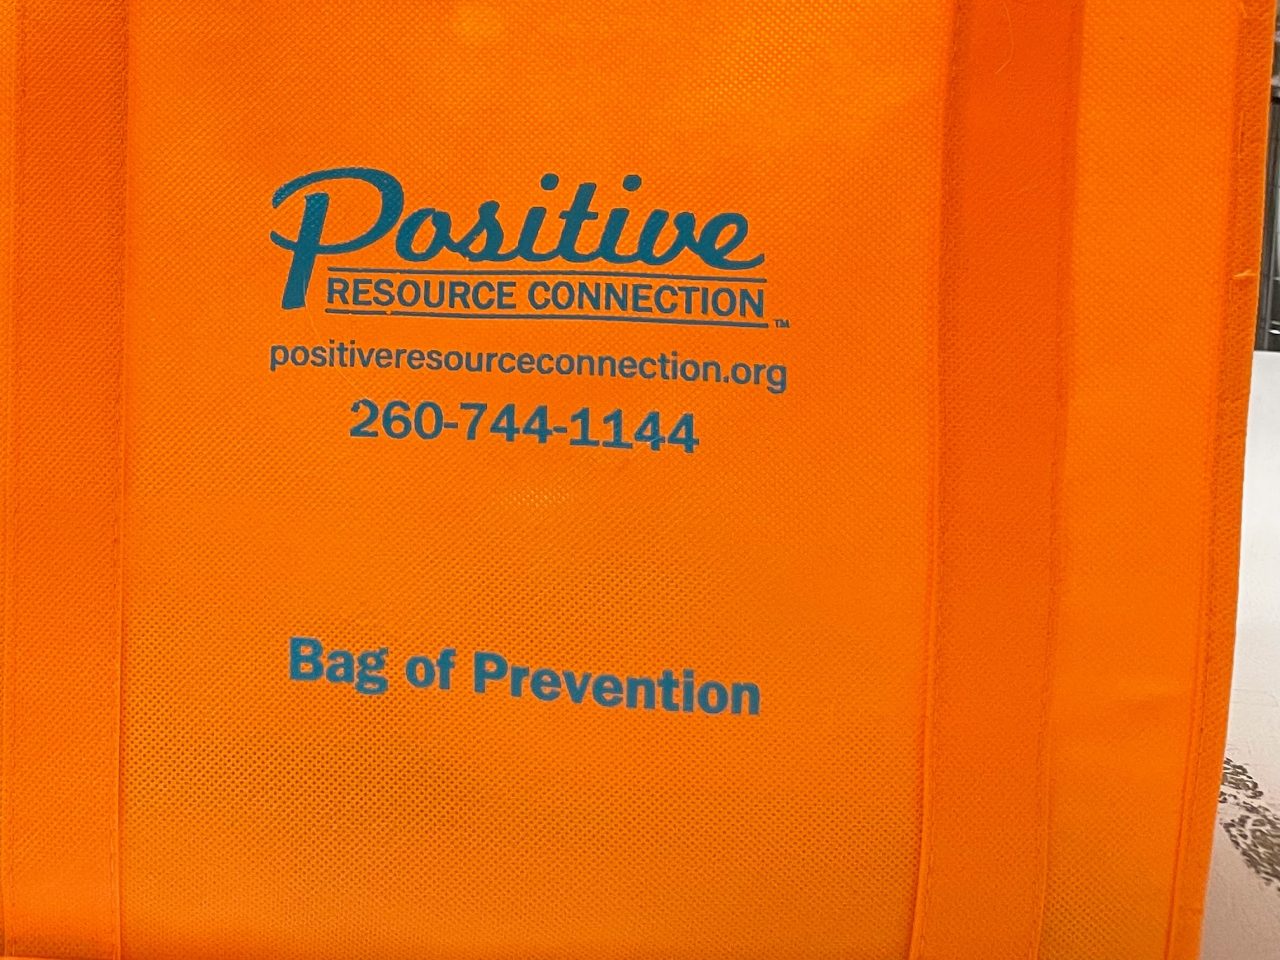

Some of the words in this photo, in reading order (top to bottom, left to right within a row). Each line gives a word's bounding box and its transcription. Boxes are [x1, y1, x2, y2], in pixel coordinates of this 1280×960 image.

[270, 167, 765, 310] Positive
[328, 277, 517, 310] RESOURCE
[527, 280, 764, 318] CONNECTION
[270, 340, 787, 395] positiveresourceconnection.org
[349, 398, 700, 454] 260-744-1144
[289, 636, 389, 696] Bag
[405, 648, 457, 690] of
[473, 651, 760, 716] Prevention
